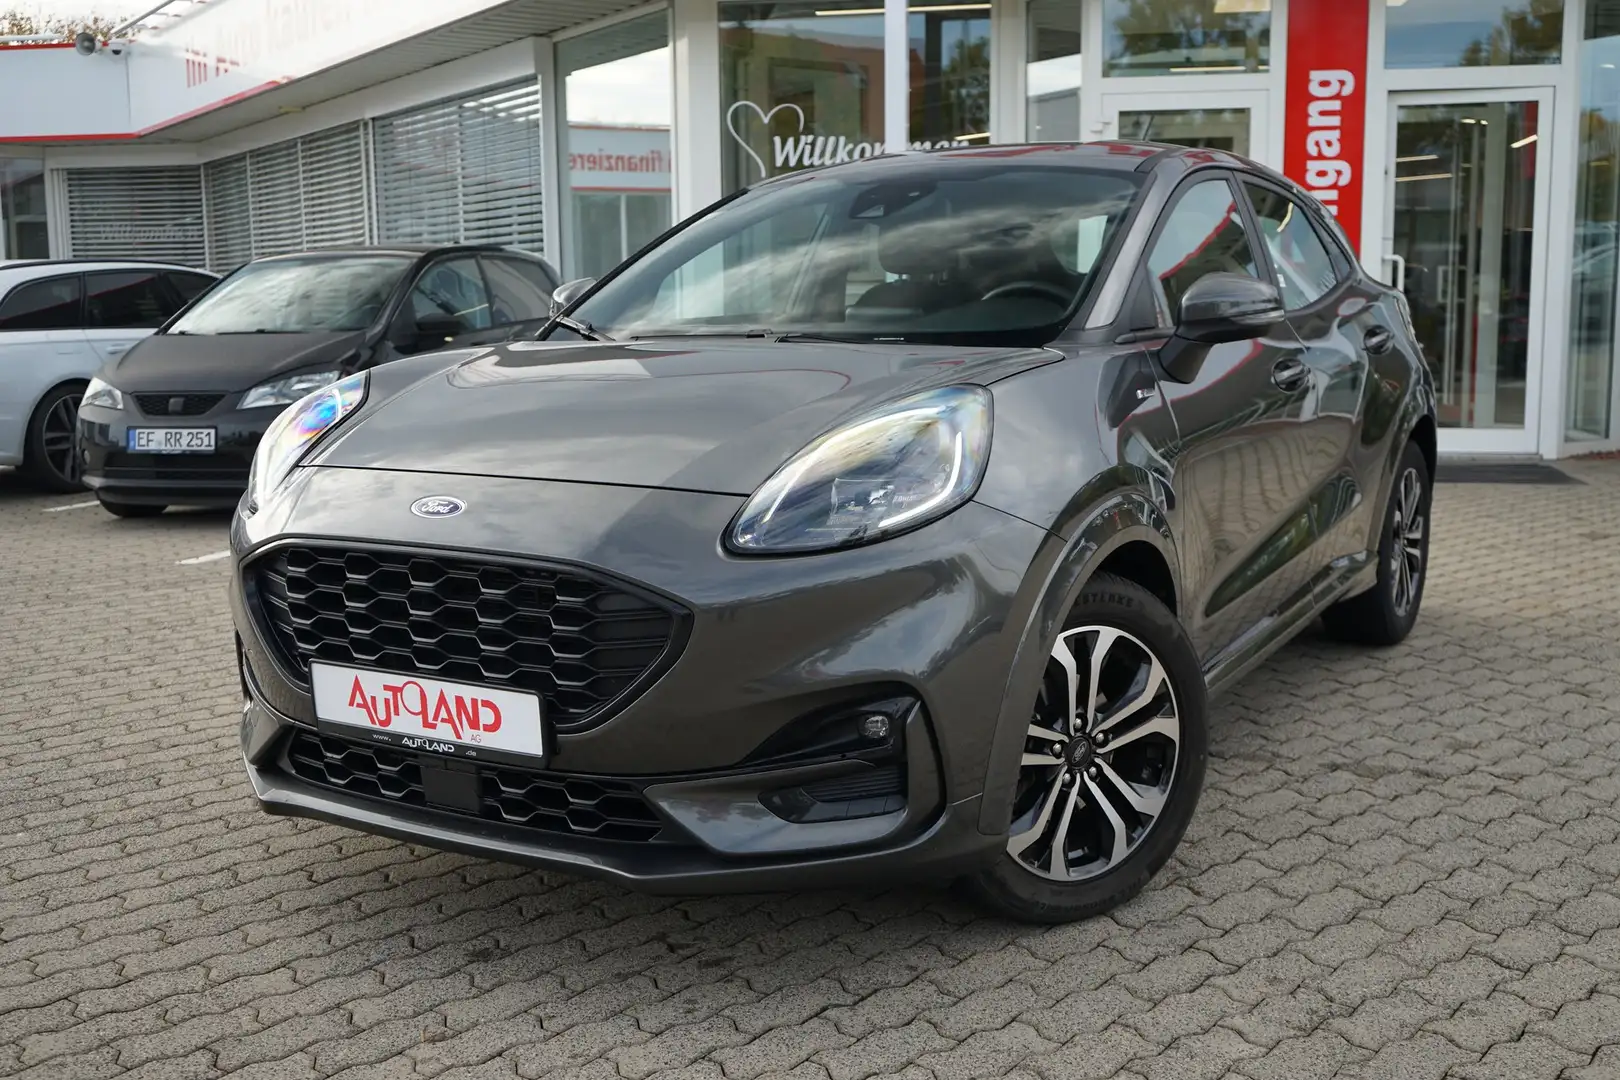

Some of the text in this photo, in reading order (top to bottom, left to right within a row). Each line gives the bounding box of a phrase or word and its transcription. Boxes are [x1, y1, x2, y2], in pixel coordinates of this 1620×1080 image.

[137, 431, 213, 448] EF RR 251
[421, 500, 454, 514] Ford
[470, 734, 482, 743] AG
